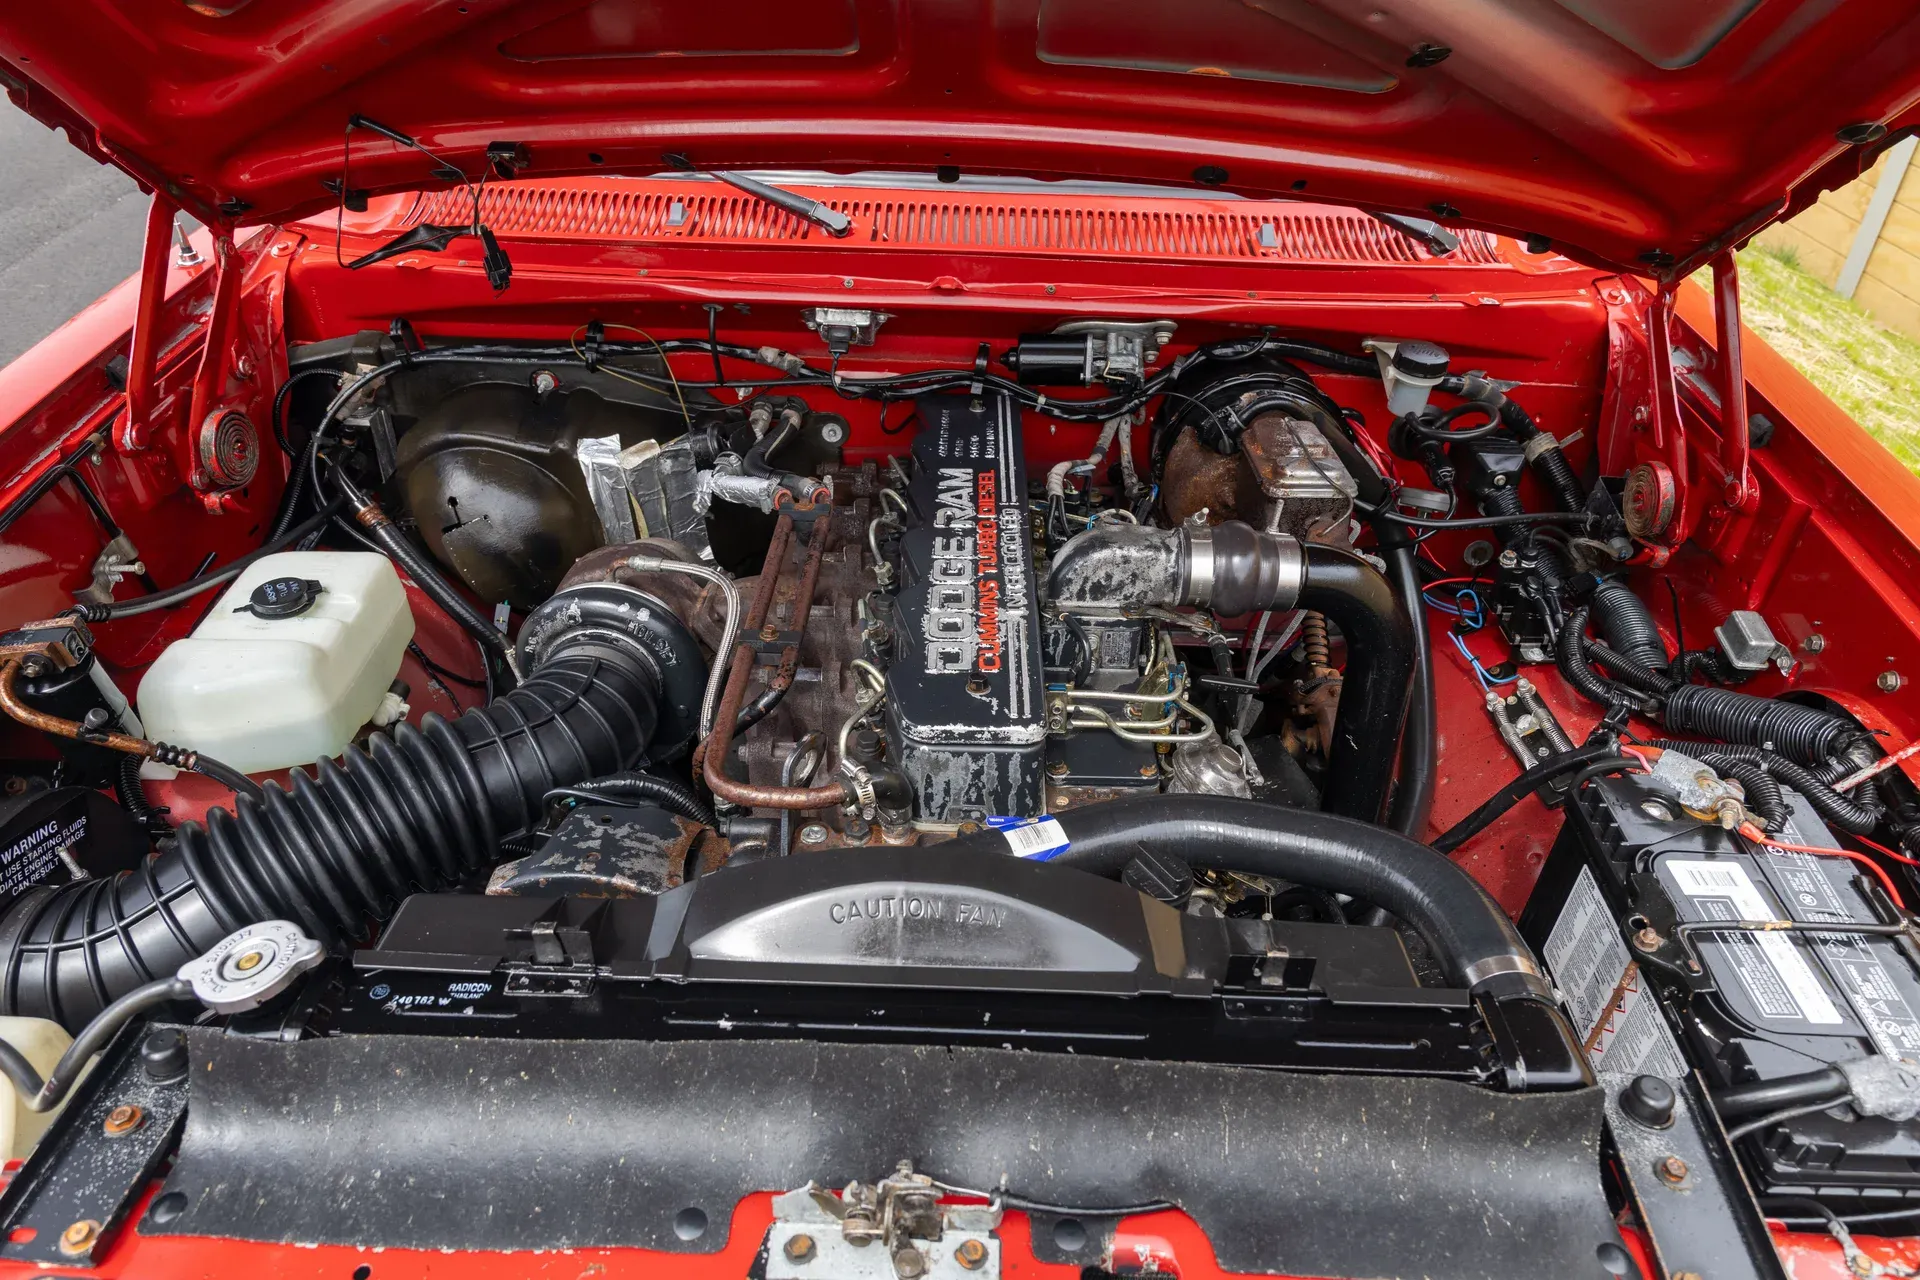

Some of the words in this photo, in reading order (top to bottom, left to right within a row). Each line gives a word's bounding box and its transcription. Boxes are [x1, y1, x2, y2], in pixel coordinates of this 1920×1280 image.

[934, 468, 977, 528] RAM
[977, 469, 996, 518] DIESEL
[977, 520, 998, 572] TURBO
[1001, 508, 1028, 615] INTERCOOLED
[925, 536, 977, 673] DODGE
[977, 578, 1000, 673] CUMMINS
[1, 820, 58, 865] WARNING
[5, 862, 22, 877] USE
[23, 834, 62, 865] STARTING
[62, 816, 87, 839] FLUIDS
[0, 873, 24, 894] DIATE
[24, 850, 53, 876] ENGINE
[12, 879, 30, 896] CAN
[30, 857, 59, 884] RESULT
[829, 894, 942, 925] CAUTION
[955, 903, 1006, 928] FAN
[438, 997, 451, 1006] W
[448, 982, 492, 992] RADICON
